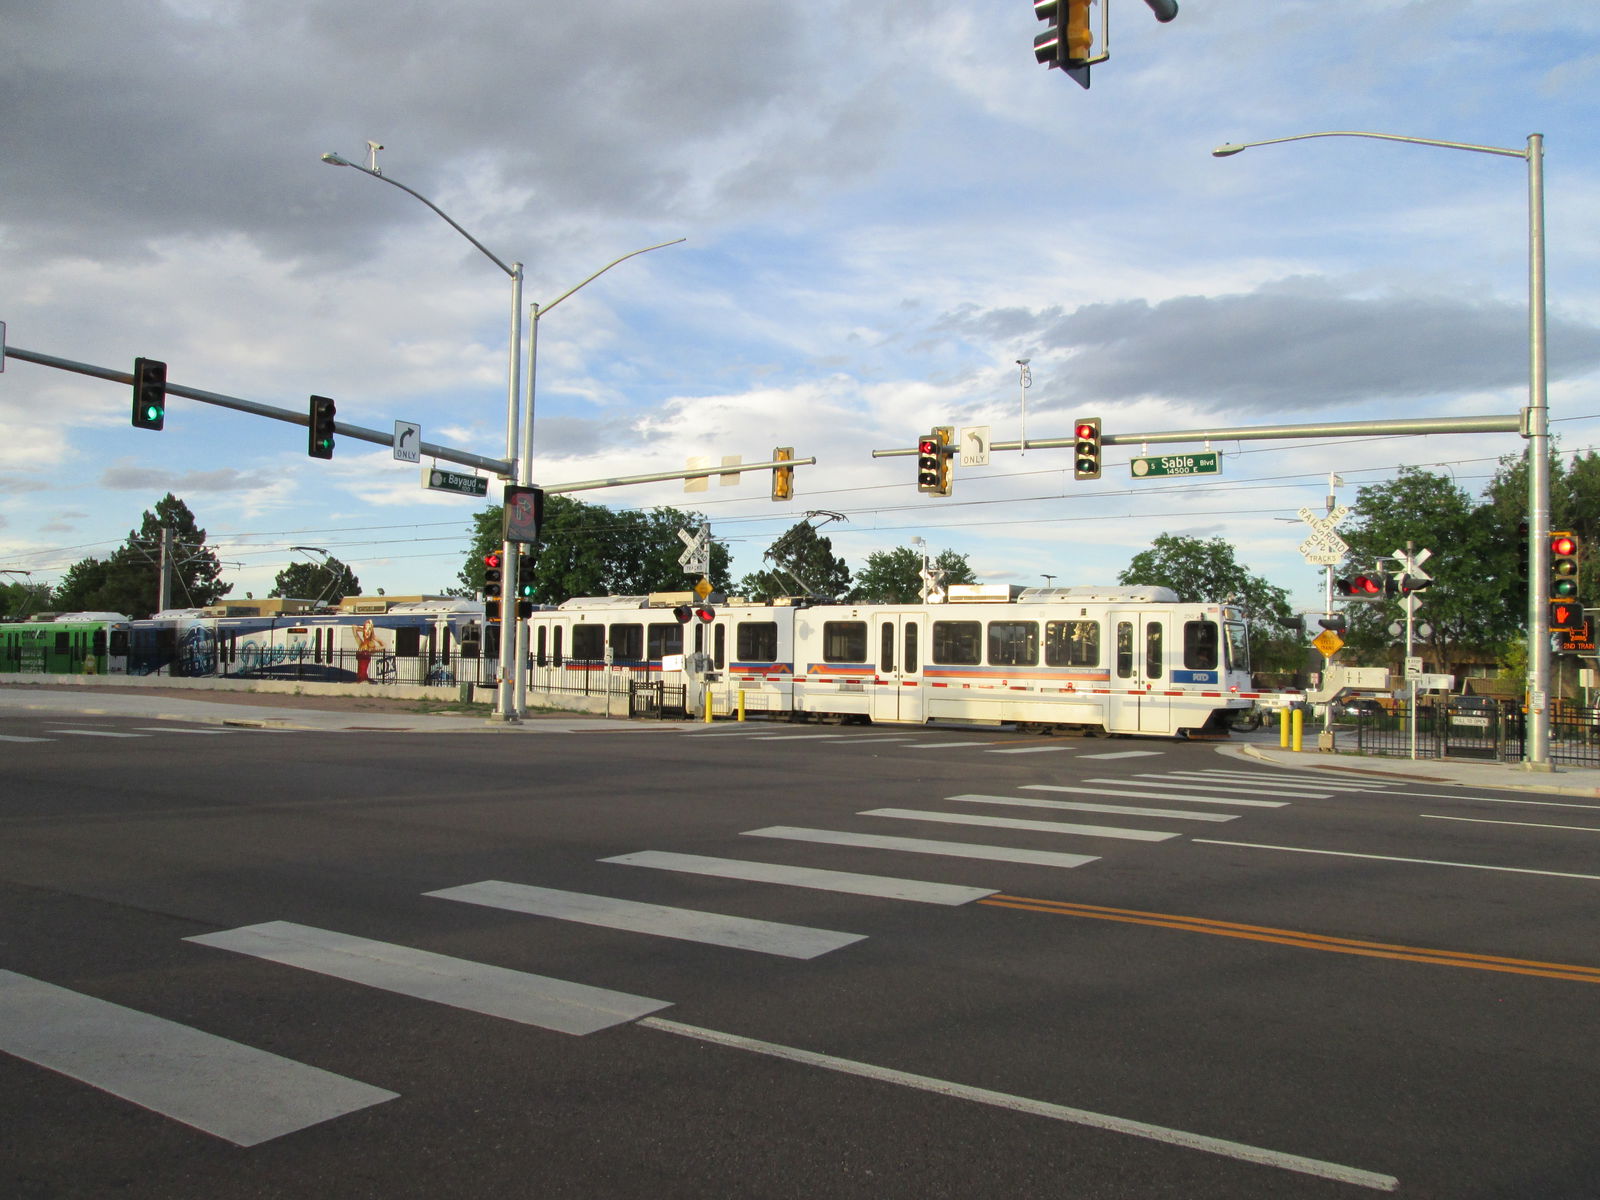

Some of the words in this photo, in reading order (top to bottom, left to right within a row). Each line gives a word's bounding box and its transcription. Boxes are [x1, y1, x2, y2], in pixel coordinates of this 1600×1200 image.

[397, 449, 417, 459] ONLY
[963, 455, 985, 464] ONLY
[1161, 456, 1194, 469] Sable
[1199, 459, 1214, 467] Blvd
[1166, 467, 1190, 475] 14500
[448, 474, 477, 488] Bayaud
[1299, 506, 1346, 554] CROSSING
